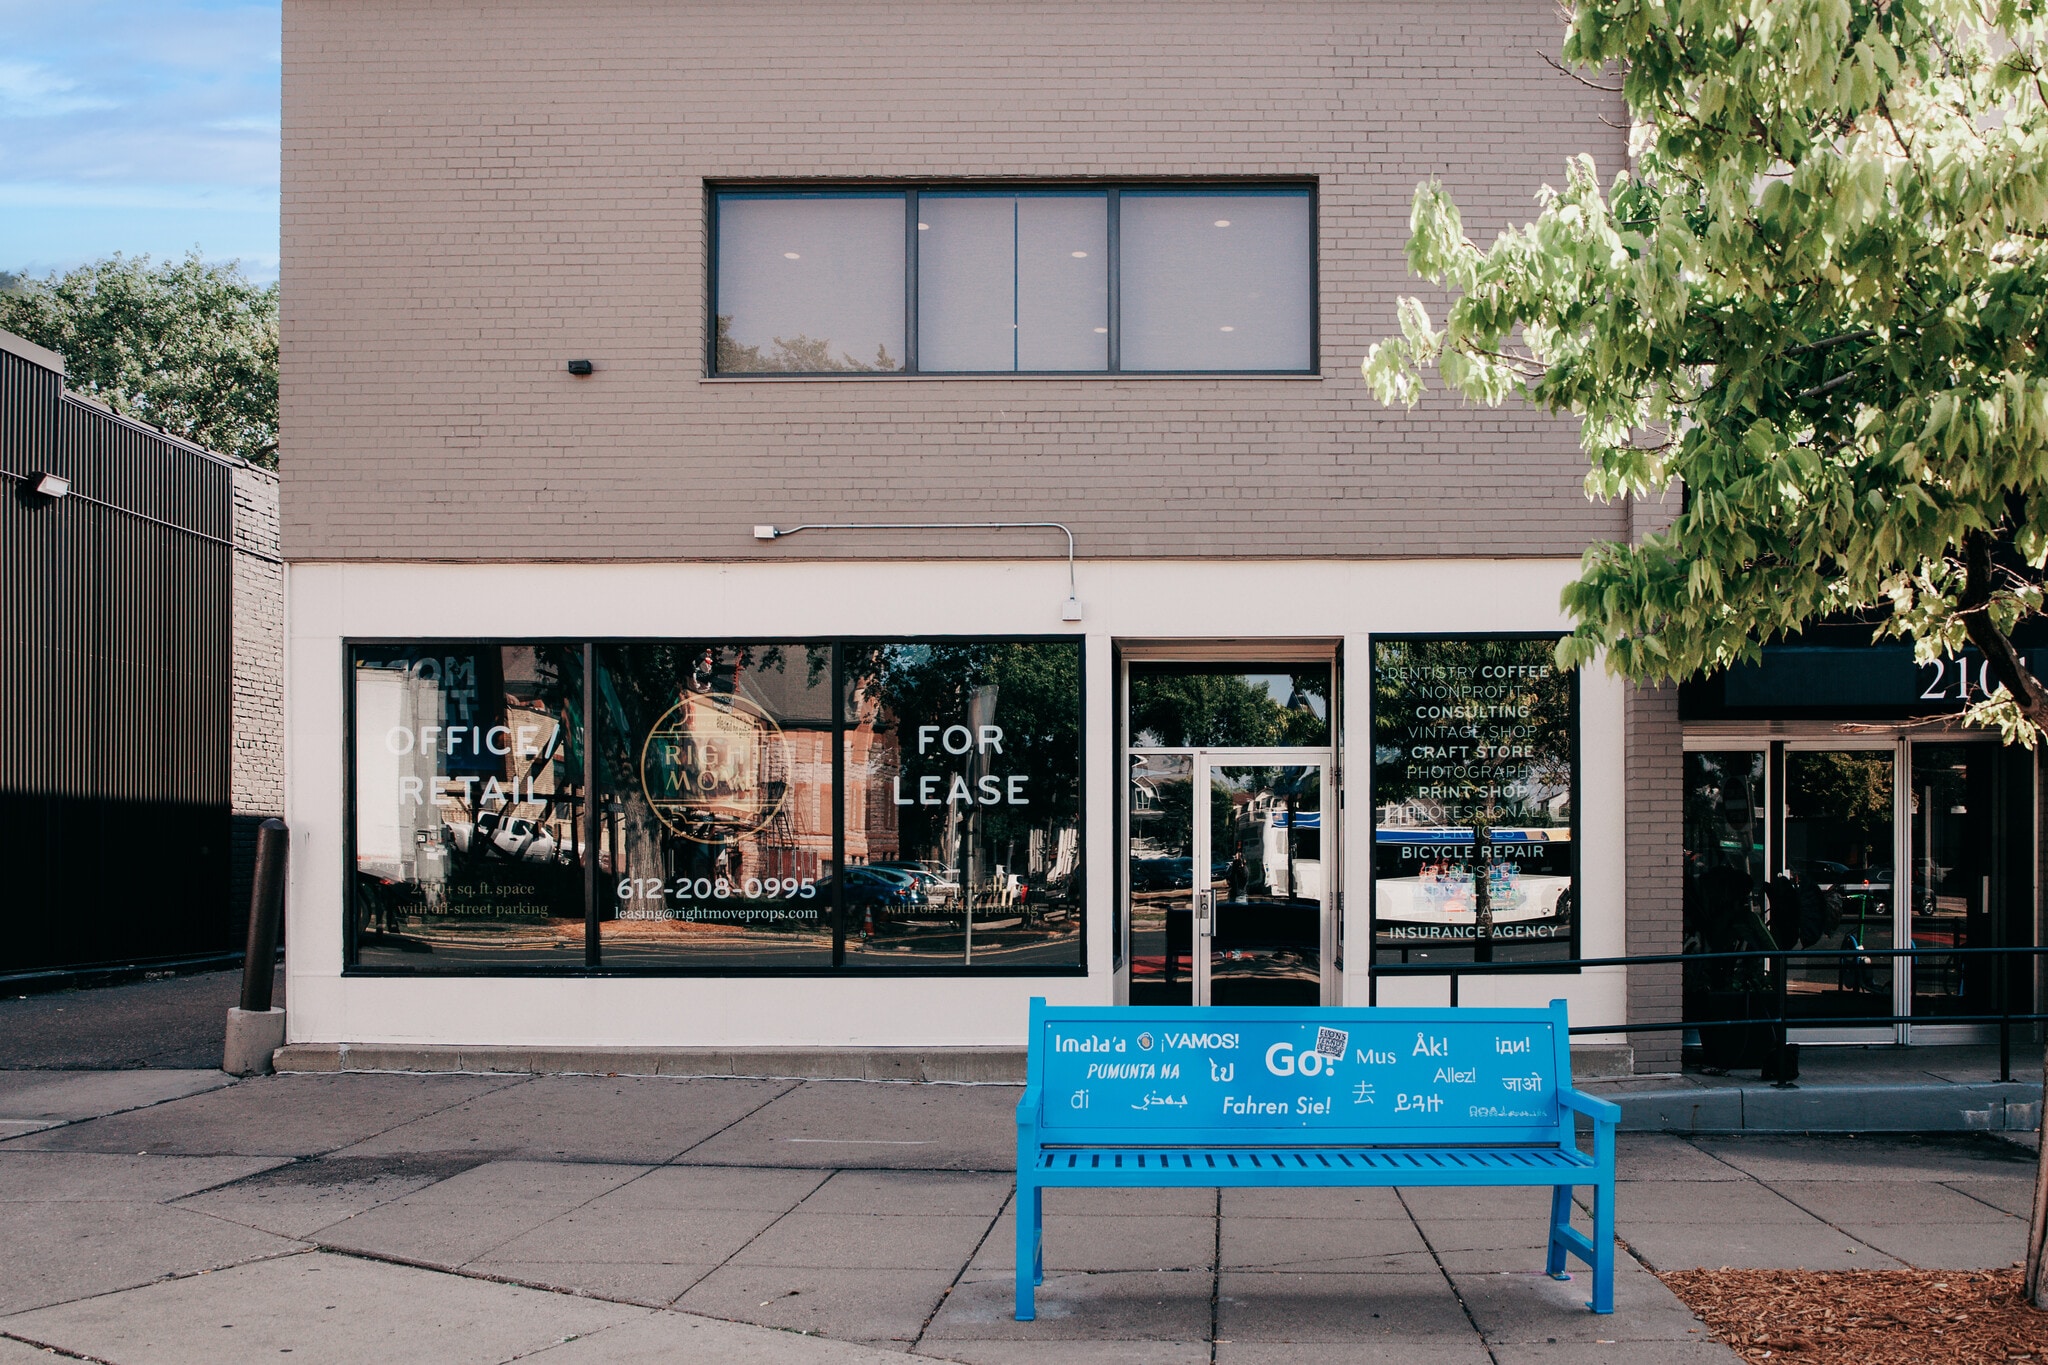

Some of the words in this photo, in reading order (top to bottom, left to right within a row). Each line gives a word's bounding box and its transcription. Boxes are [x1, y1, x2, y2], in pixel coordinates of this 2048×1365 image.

[1388, 667, 1478, 680] DENTISTRY
[1481, 665, 1550, 679] COFFEE
[1421, 685, 1524, 699] NONPROFIT
[1415, 706, 1530, 719] CONSULTING
[918, 725, 1004, 755] FOR
[1407, 726, 1484, 739] VINTAGE
[1488, 725, 1538, 738] SHOP
[385, 723, 560, 759] OFFICE/
[1411, 746, 1469, 759] CRAFT
[1476, 745, 1534, 759] STORE
[400, 775, 548, 805] RETAIL
[893, 775, 1030, 805] LEASE
[1418, 786, 1474, 799] PRINT
[1478, 785, 1528, 798] SHOP
[1405, 805, 1540, 819] PROFESSIONAL
[1401, 846, 1474, 859] BICYCLE
[1481, 845, 1544, 858] REPAIR
[457, 885, 476, 898] sq.
[480, 881, 493, 895] ft.
[496, 884, 535, 898] space
[616, 877, 816, 899] 612-208-0995
[398, 901, 428, 914] with
[496, 901, 549, 918] parking
[614, 906, 818, 923] leasing@rightmoveprops.com
[1389, 926, 1486, 939] INSURANCE
[1491, 925, 1558, 938] AGENCY
[1161, 1033, 1239, 1052] ¡VAMOS!
[1412, 1032, 1448, 1056] Åk!
[1356, 1049, 1397, 1064] Mus
[1087, 1063, 1155, 1079] PUMUNTA
[1160, 1063, 1180, 1079] NA
[1433, 1067, 1476, 1083] Allez!
[1502, 1072, 1542, 1092] जाओ
[1071, 1089, 1089, 1109] đi
[1352, 1080, 1375, 1104] 去
[1223, 1095, 1289, 1115] Fahren
[1296, 1096, 1331, 1115] Sie!
